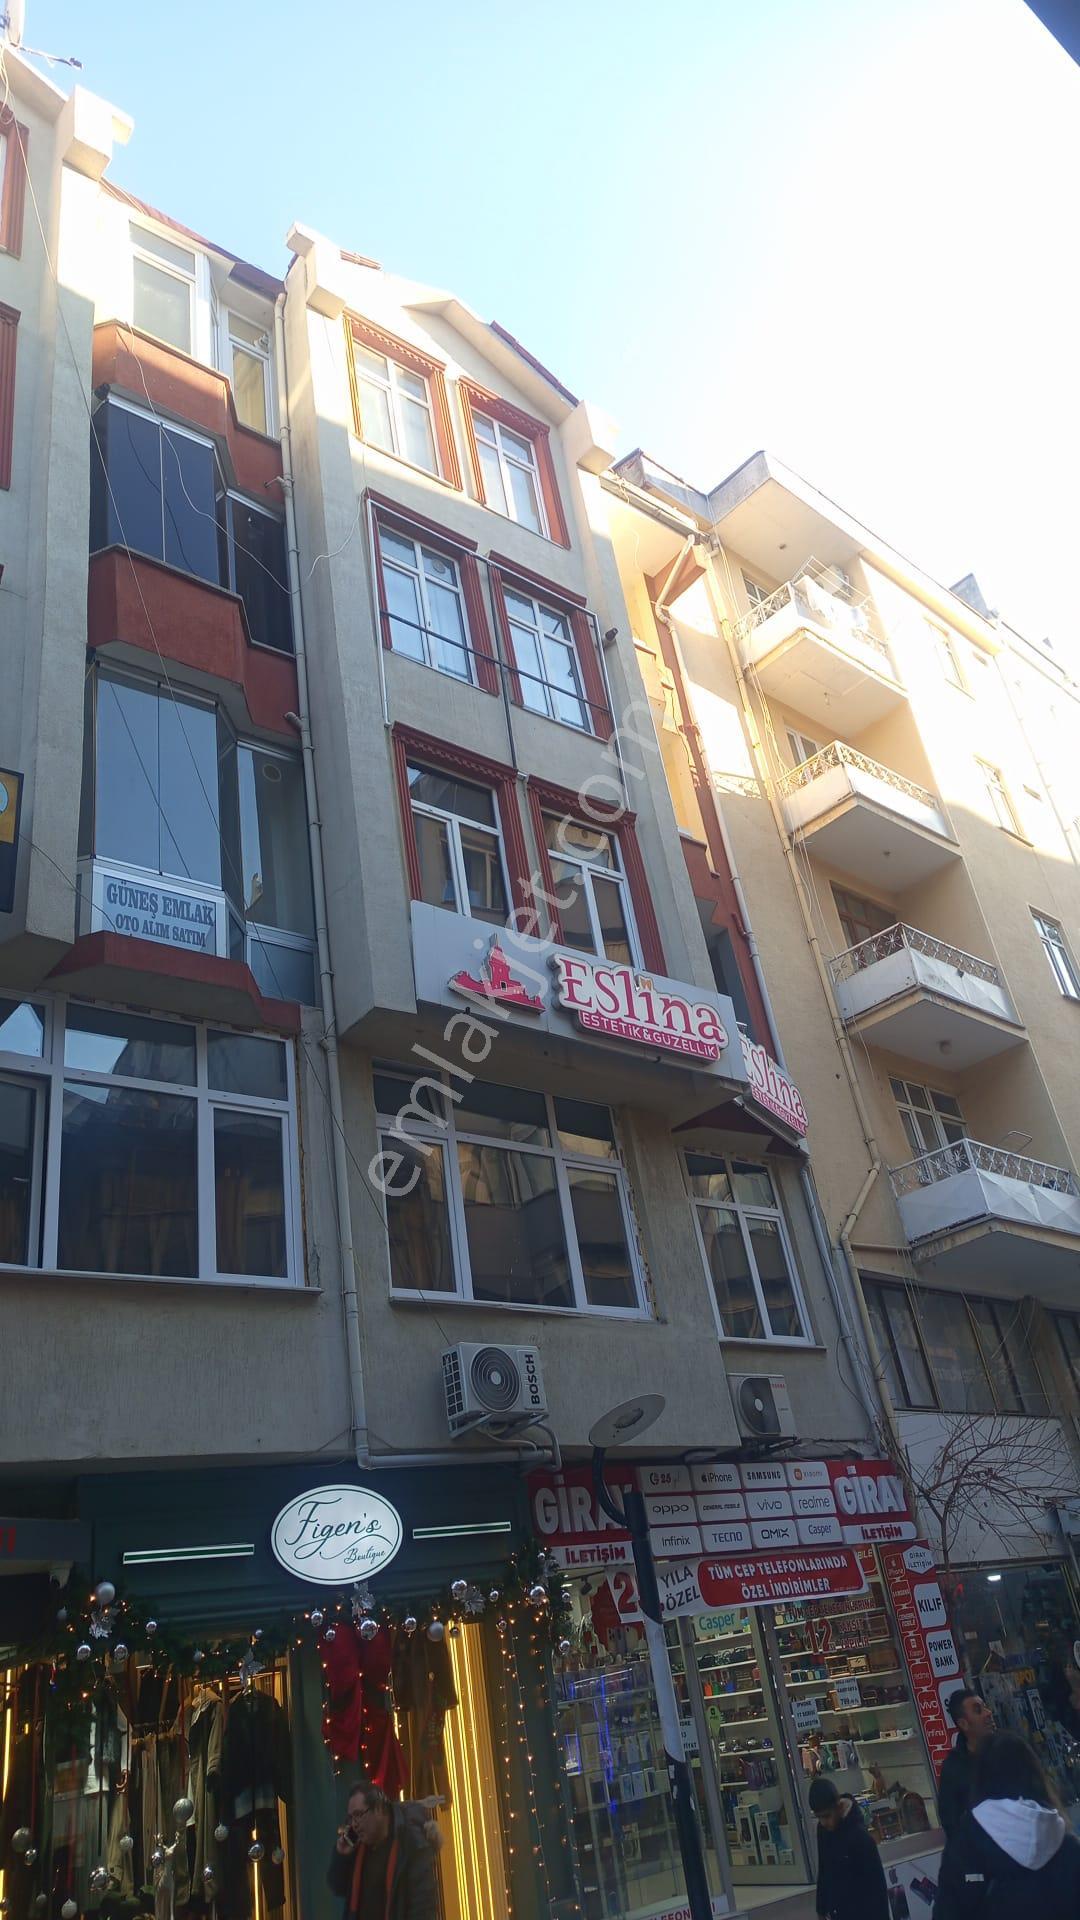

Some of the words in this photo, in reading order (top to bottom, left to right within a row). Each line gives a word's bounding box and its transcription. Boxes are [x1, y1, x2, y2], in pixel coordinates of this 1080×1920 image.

[106, 880, 159, 919] GÜNEŞ
[162, 895, 214, 927] EMLAK
[115, 913, 140, 933] OTO
[141, 919, 170, 940] ALIM
[172, 925, 207, 948] SATIM
[525, 1353, 541, 1405] BOSCH
[708, 1472, 733, 1483] iPhone
[746, 1470, 782, 1481] SAMSUNG
[652, 1503, 689, 1515] oppo
[757, 1499, 783, 1511] vivo
[798, 1496, 831, 1510] realme
[284, 1497, 382, 1560] Figen's
[760, 1528, 790, 1540] OMIX
[808, 1523, 832, 1537] Casper
[861, 1524, 903, 1541] İLETİŞİM
[711, 1531, 743, 1544] TECNO
[565, 1543, 626, 1565] İLETİŞİM
[708, 1563, 733, 1581] TÜM
[735, 1561, 756, 1579] CEP
[758, 1555, 848, 1576] TELEFONLARINDA
[660, 1565, 694, 1589] YILA
[666, 1585, 701, 1610] ÖZEL
[741, 1581, 770, 1600] ÖZEL
[771, 1578, 831, 1598] İNDİRİMLER
[918, 1598, 942, 1613] KILIF
[699, 1611, 736, 1632] Casper
[803, 1618, 832, 1656] 12
[928, 1639, 953, 1653] POWER
[935, 1655, 955, 1668] BANK
